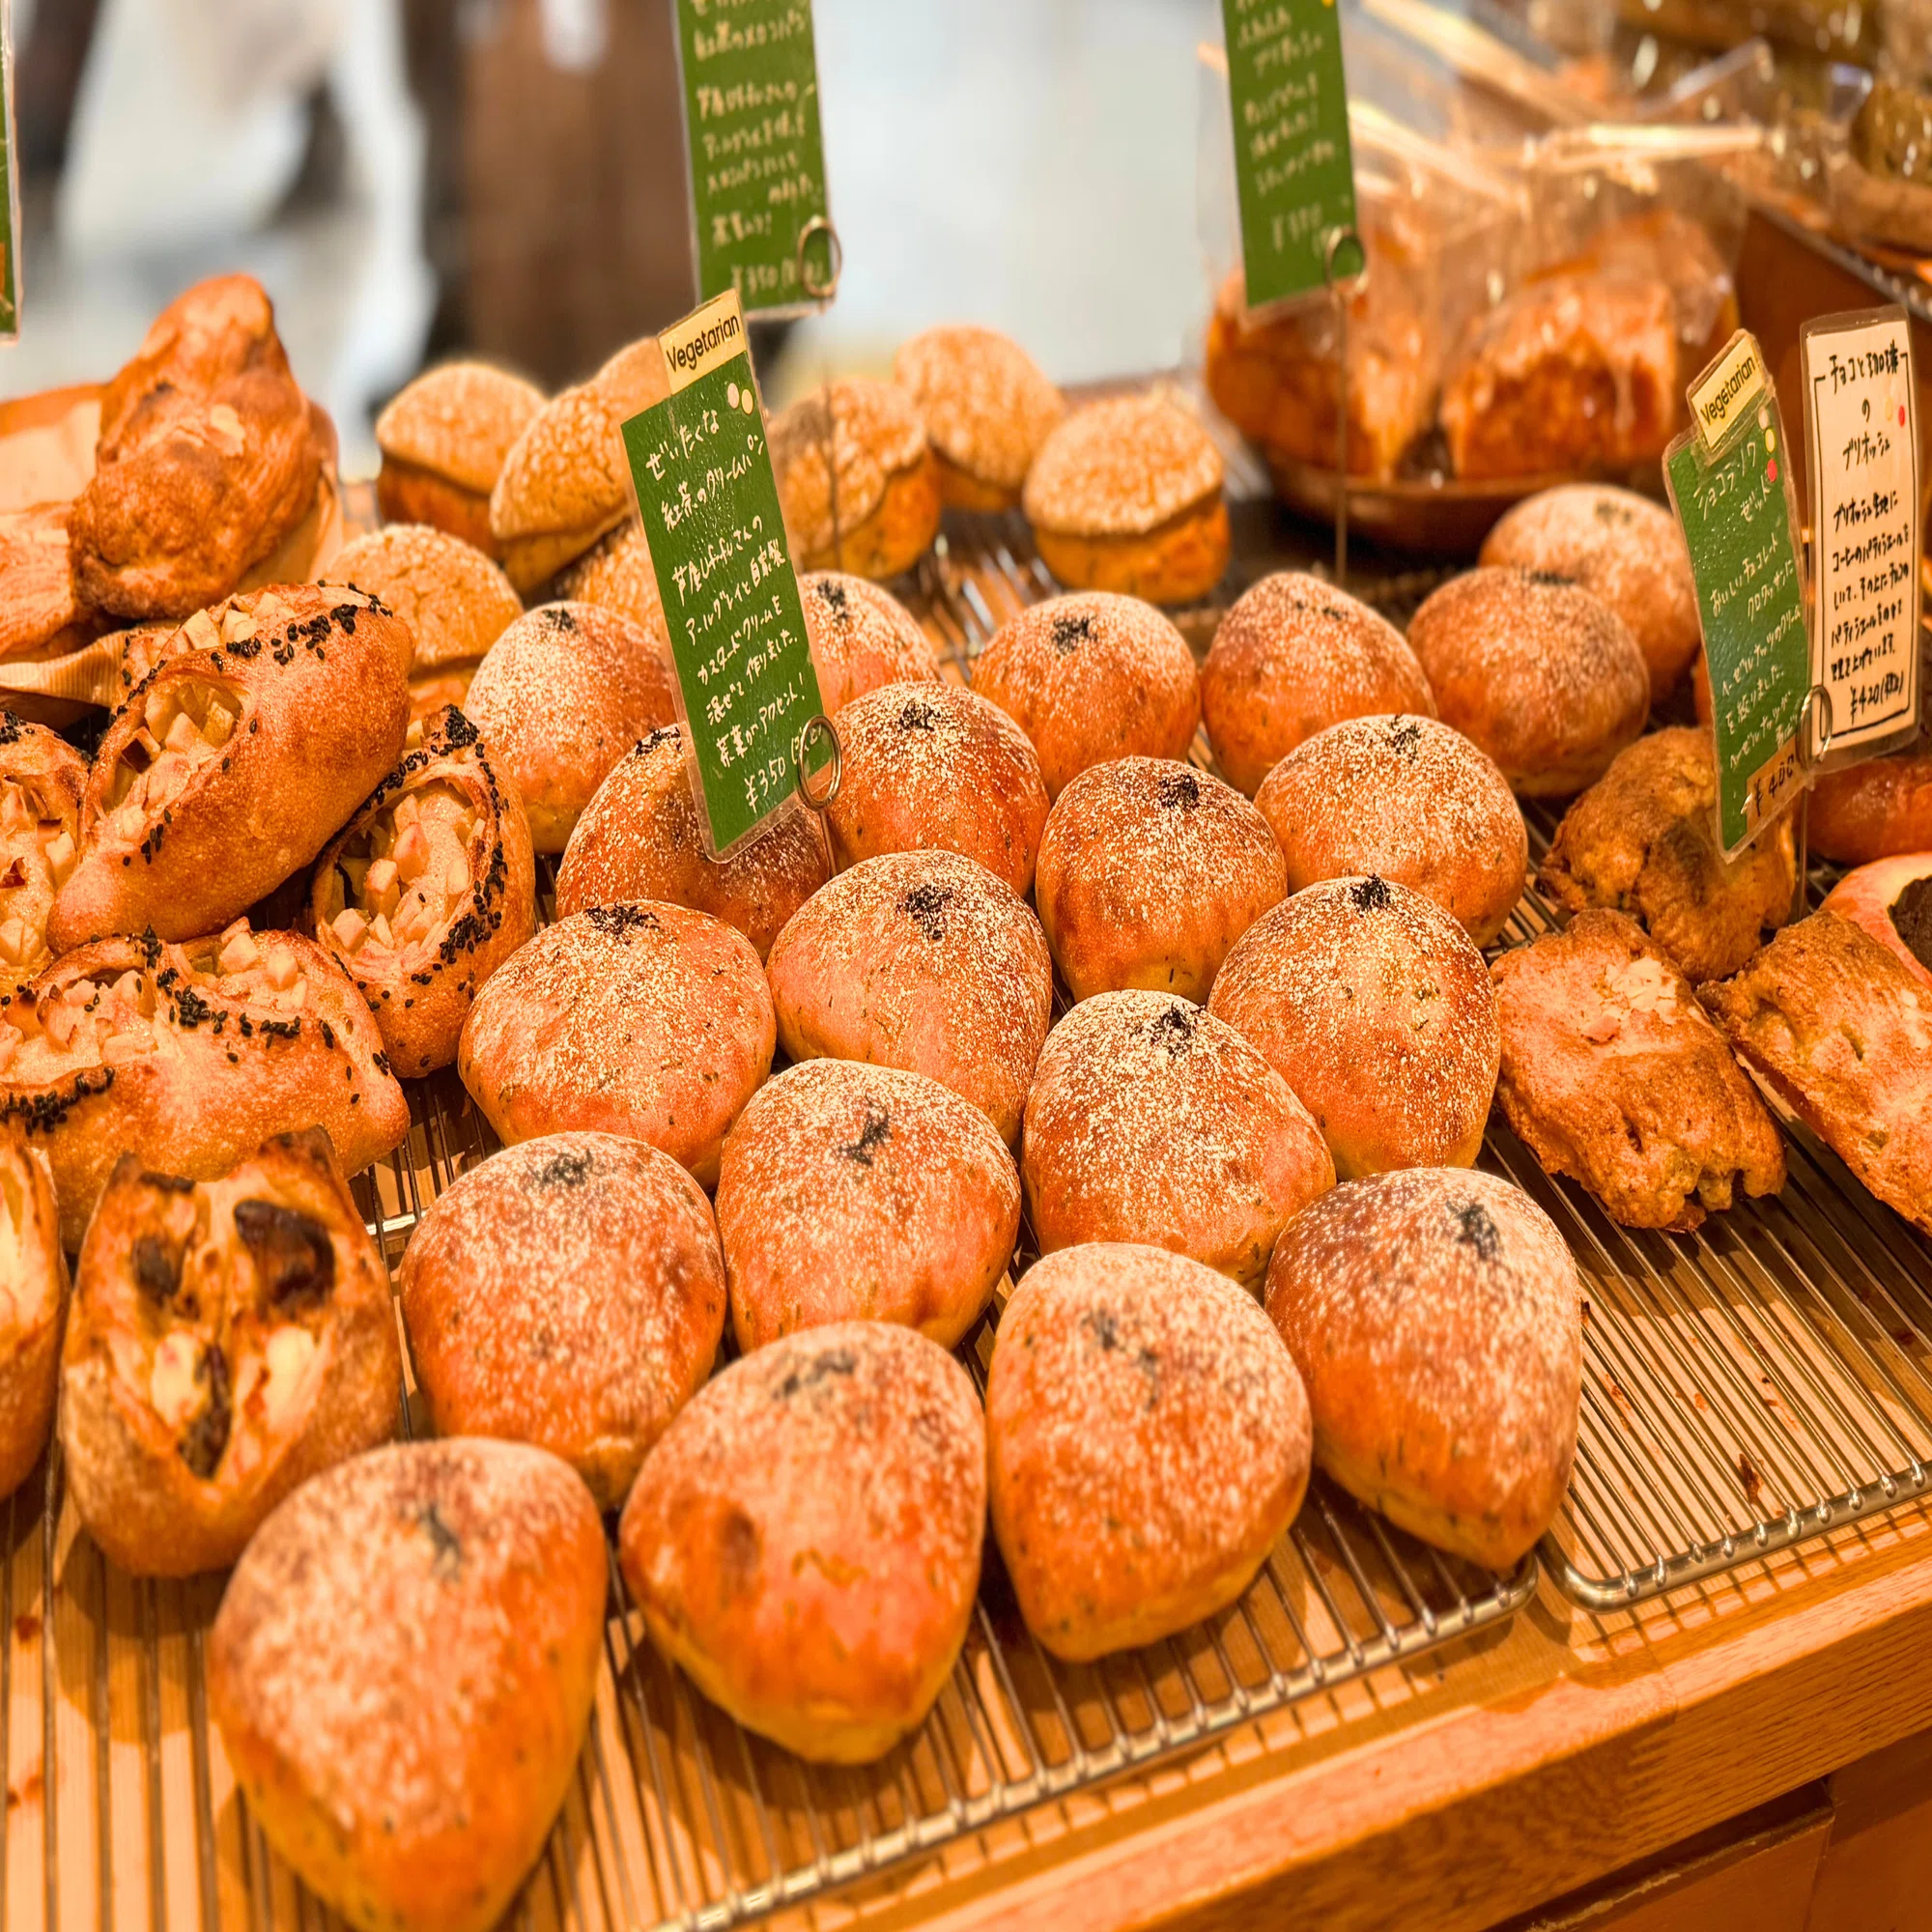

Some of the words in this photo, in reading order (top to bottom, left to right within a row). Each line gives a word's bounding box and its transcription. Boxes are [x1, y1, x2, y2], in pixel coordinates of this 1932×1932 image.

[667, 314, 740, 372] Vegetarian
[1829, 339, 1899, 395] チョコと珈琲
[1700, 355, 1756, 426] Vegetarian
[1861, 398, 1871, 423] の
[645, 410, 720, 481] ぜいたくな
[1842, 431, 1890, 471] ブリオッシュ
[661, 434, 764, 531] 紅茶のクリームパン
[1710, 532, 1778, 617] おいしいチョコレート
[697, 595, 782, 685] カスタードクリームを
[744, 756, 786, 813] ¥350
